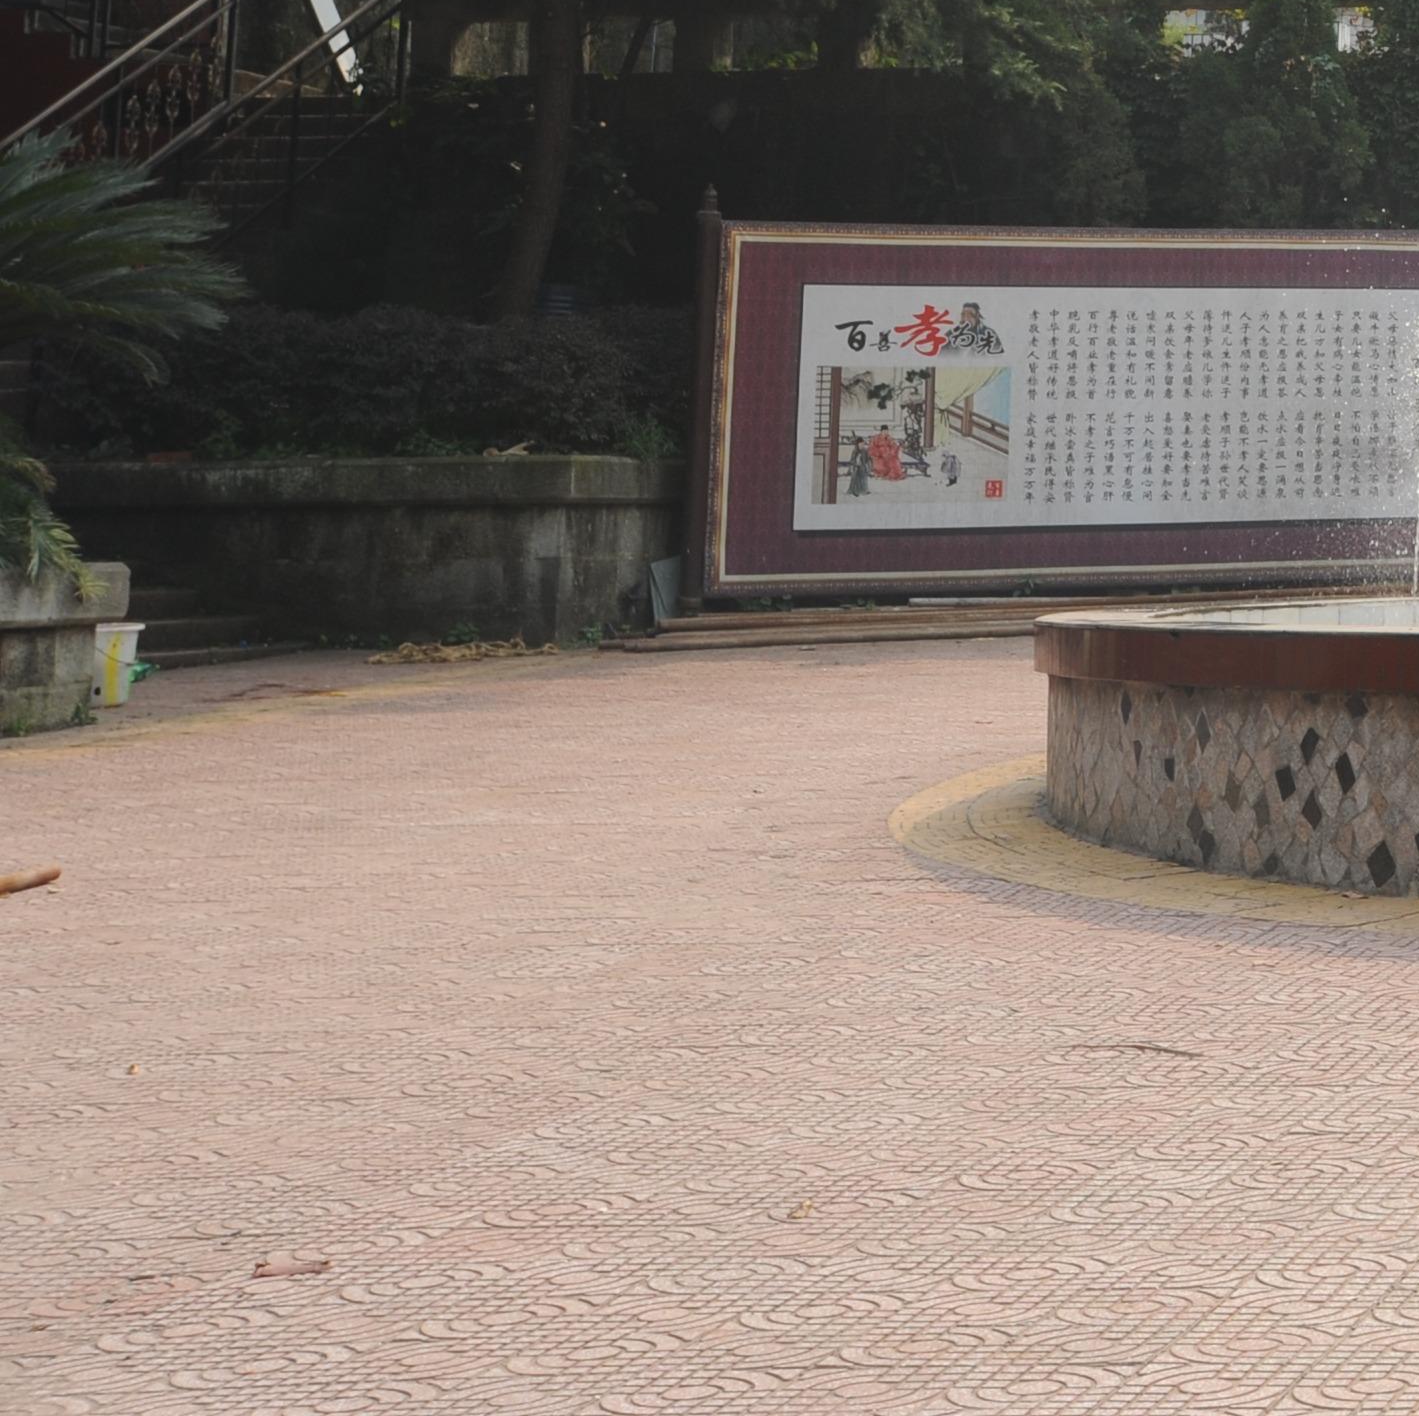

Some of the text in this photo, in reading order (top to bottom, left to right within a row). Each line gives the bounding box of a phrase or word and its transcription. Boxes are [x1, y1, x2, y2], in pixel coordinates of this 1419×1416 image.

[835, 304, 1004, 357] 百善孝为先
